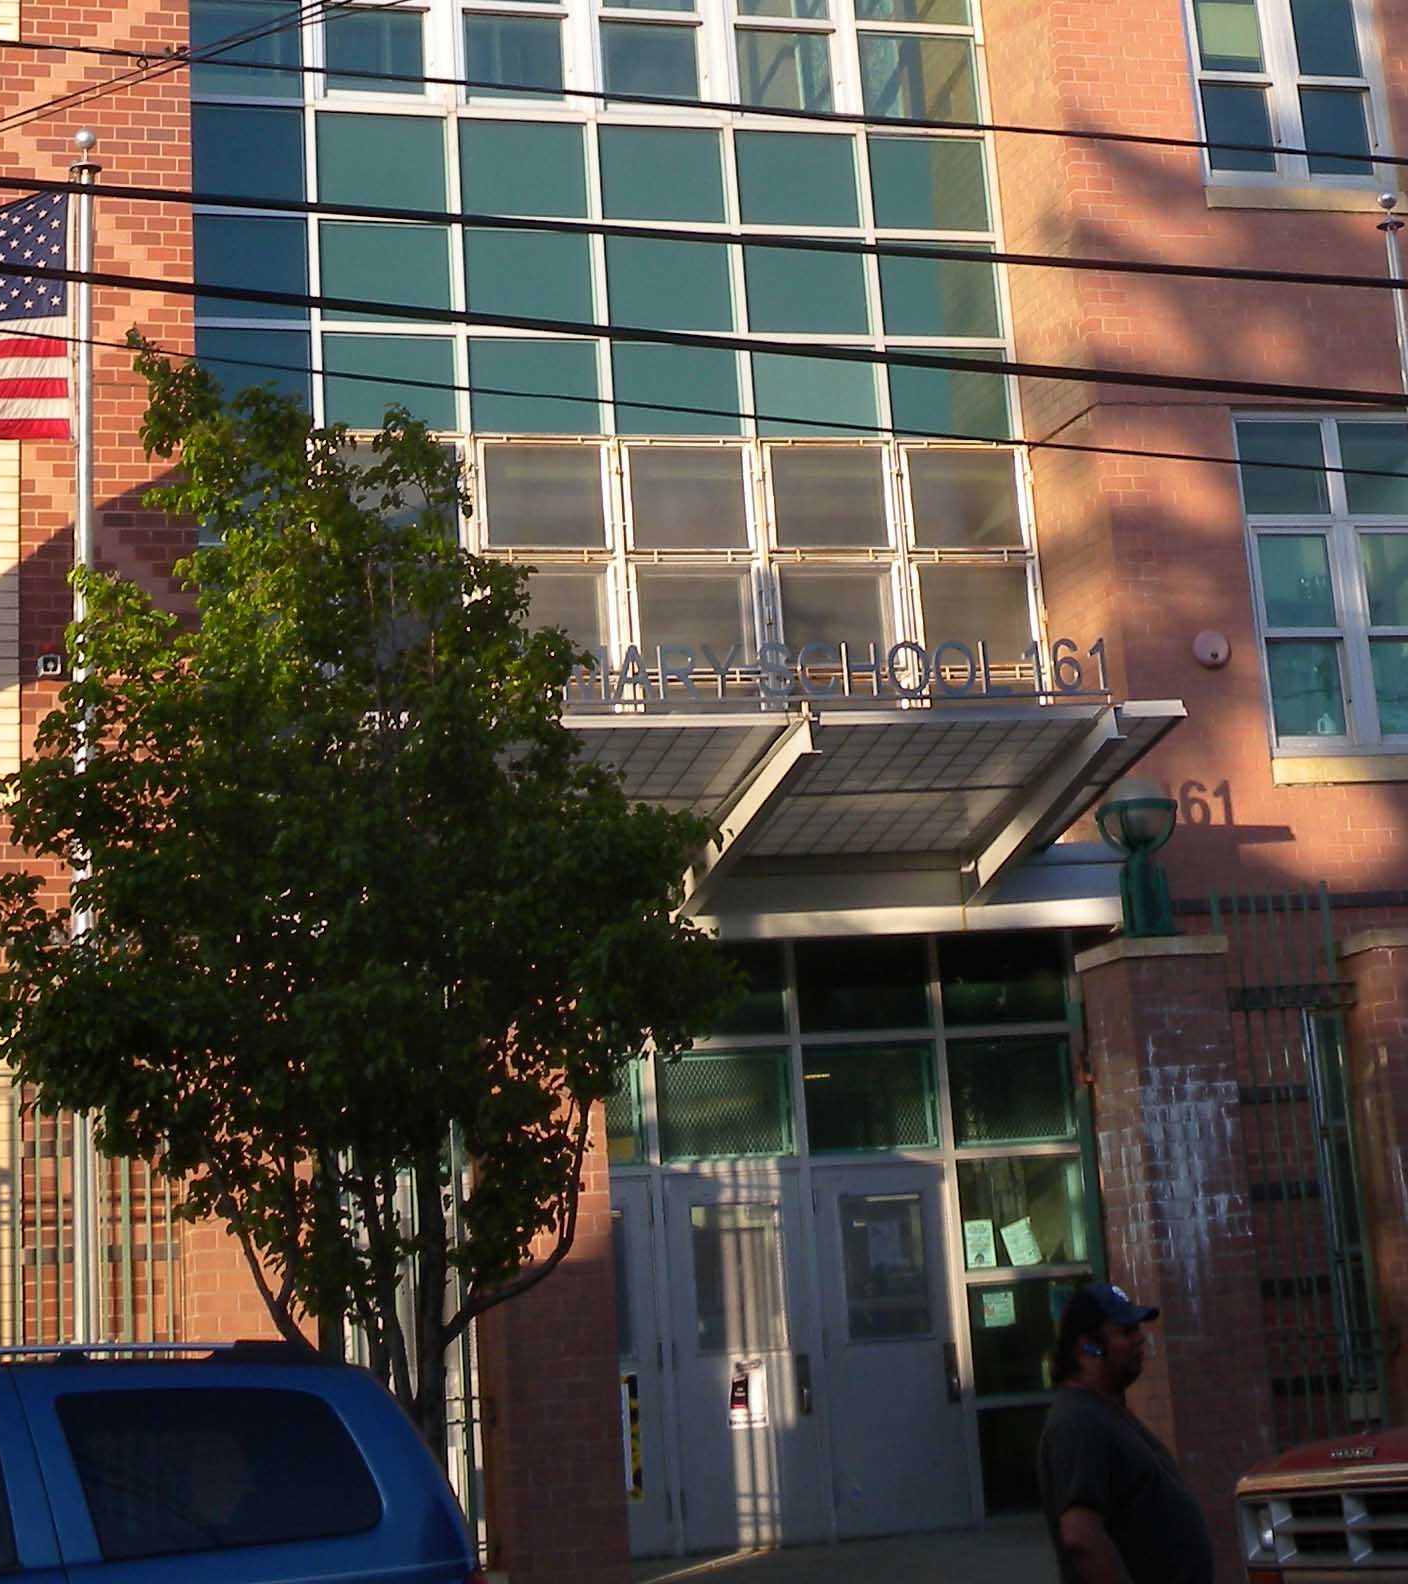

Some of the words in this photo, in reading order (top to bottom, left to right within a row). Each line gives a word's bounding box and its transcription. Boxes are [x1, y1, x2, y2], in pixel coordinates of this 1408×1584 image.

[562, 643, 741, 702] MARY
[758, 638, 1014, 698] SCHOOL
[1020, 637, 1108, 693] 161
